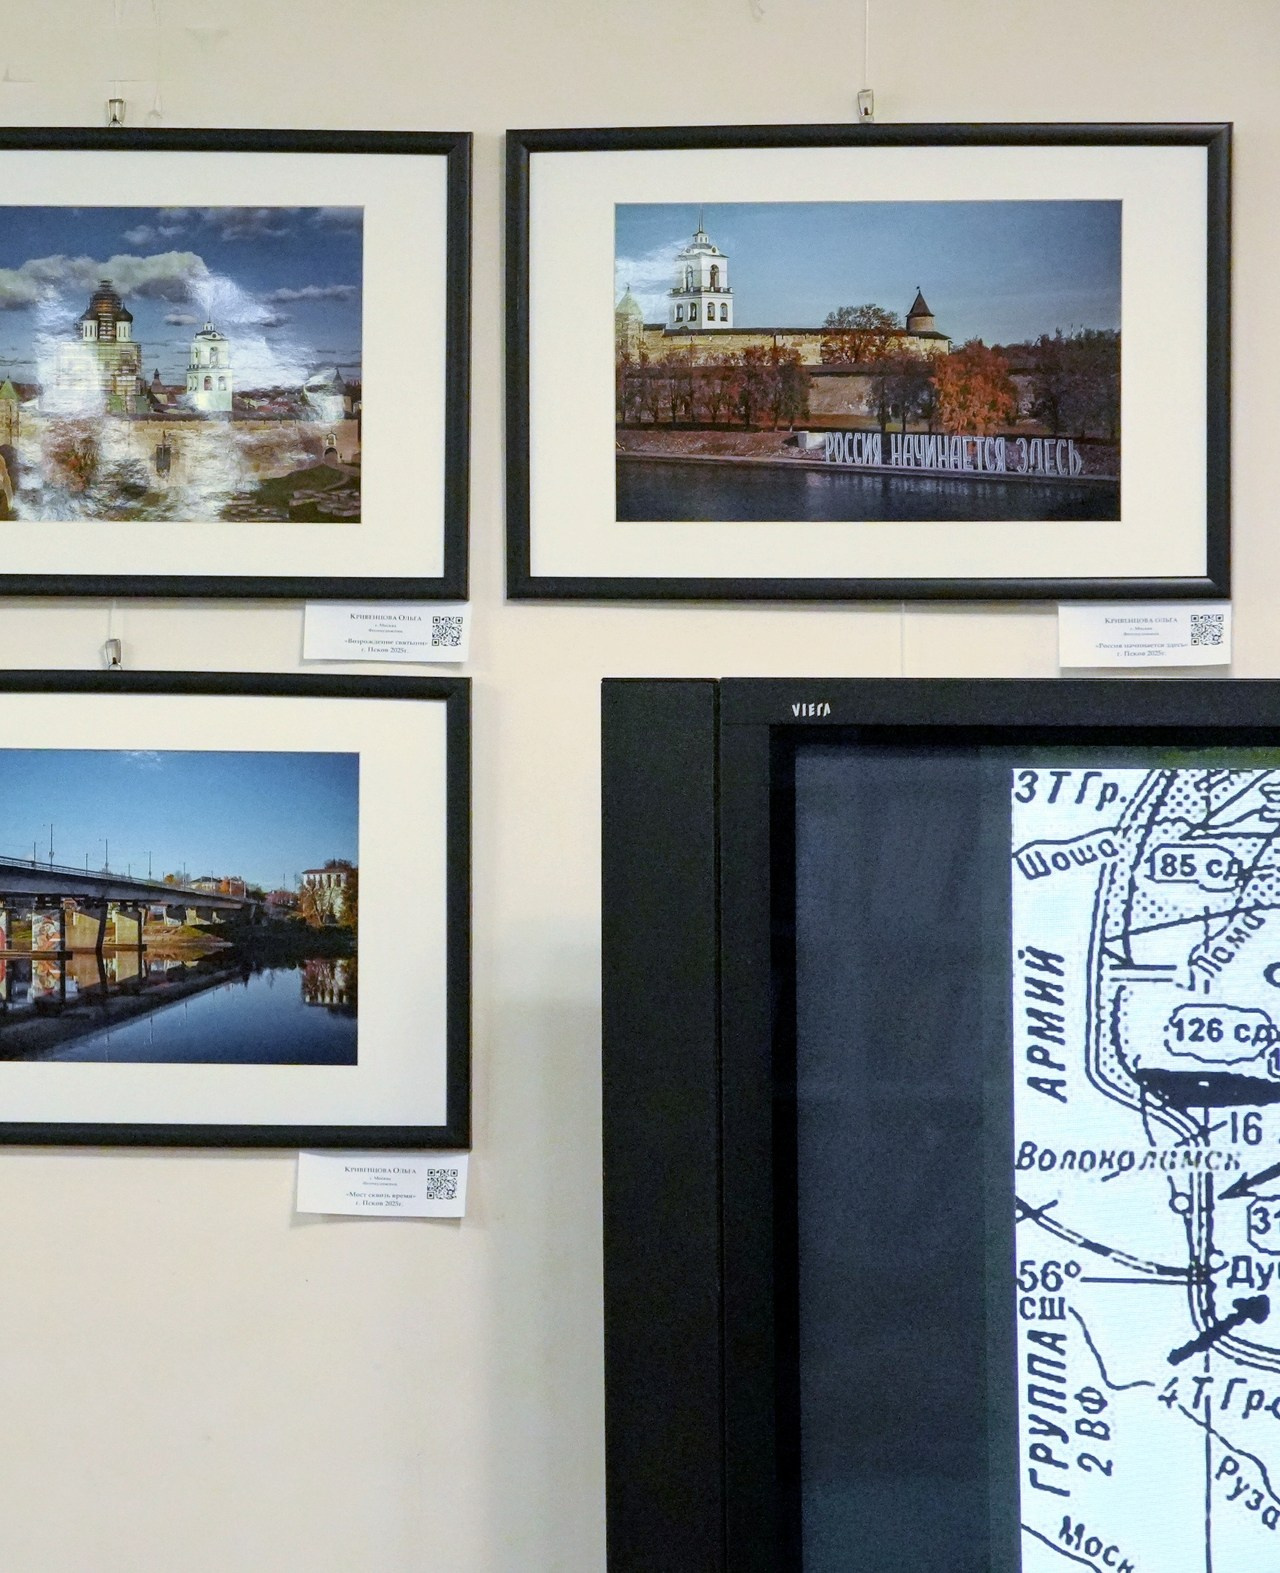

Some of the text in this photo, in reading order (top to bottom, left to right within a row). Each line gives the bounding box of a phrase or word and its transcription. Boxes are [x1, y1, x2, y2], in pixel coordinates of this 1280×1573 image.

[825, 432, 1083, 475] РОССИЯ НАЧИНАЕТСЯ ЗДЕСЬ
[1019, 838, 1119, 880] Шоша
[1173, 1017, 1224, 1043] 126
[1231, 1111, 1263, 1146] 16
[1226, 1255, 1280, 1291] Ду
[1027, 1329, 1070, 1497] ГРУППА
